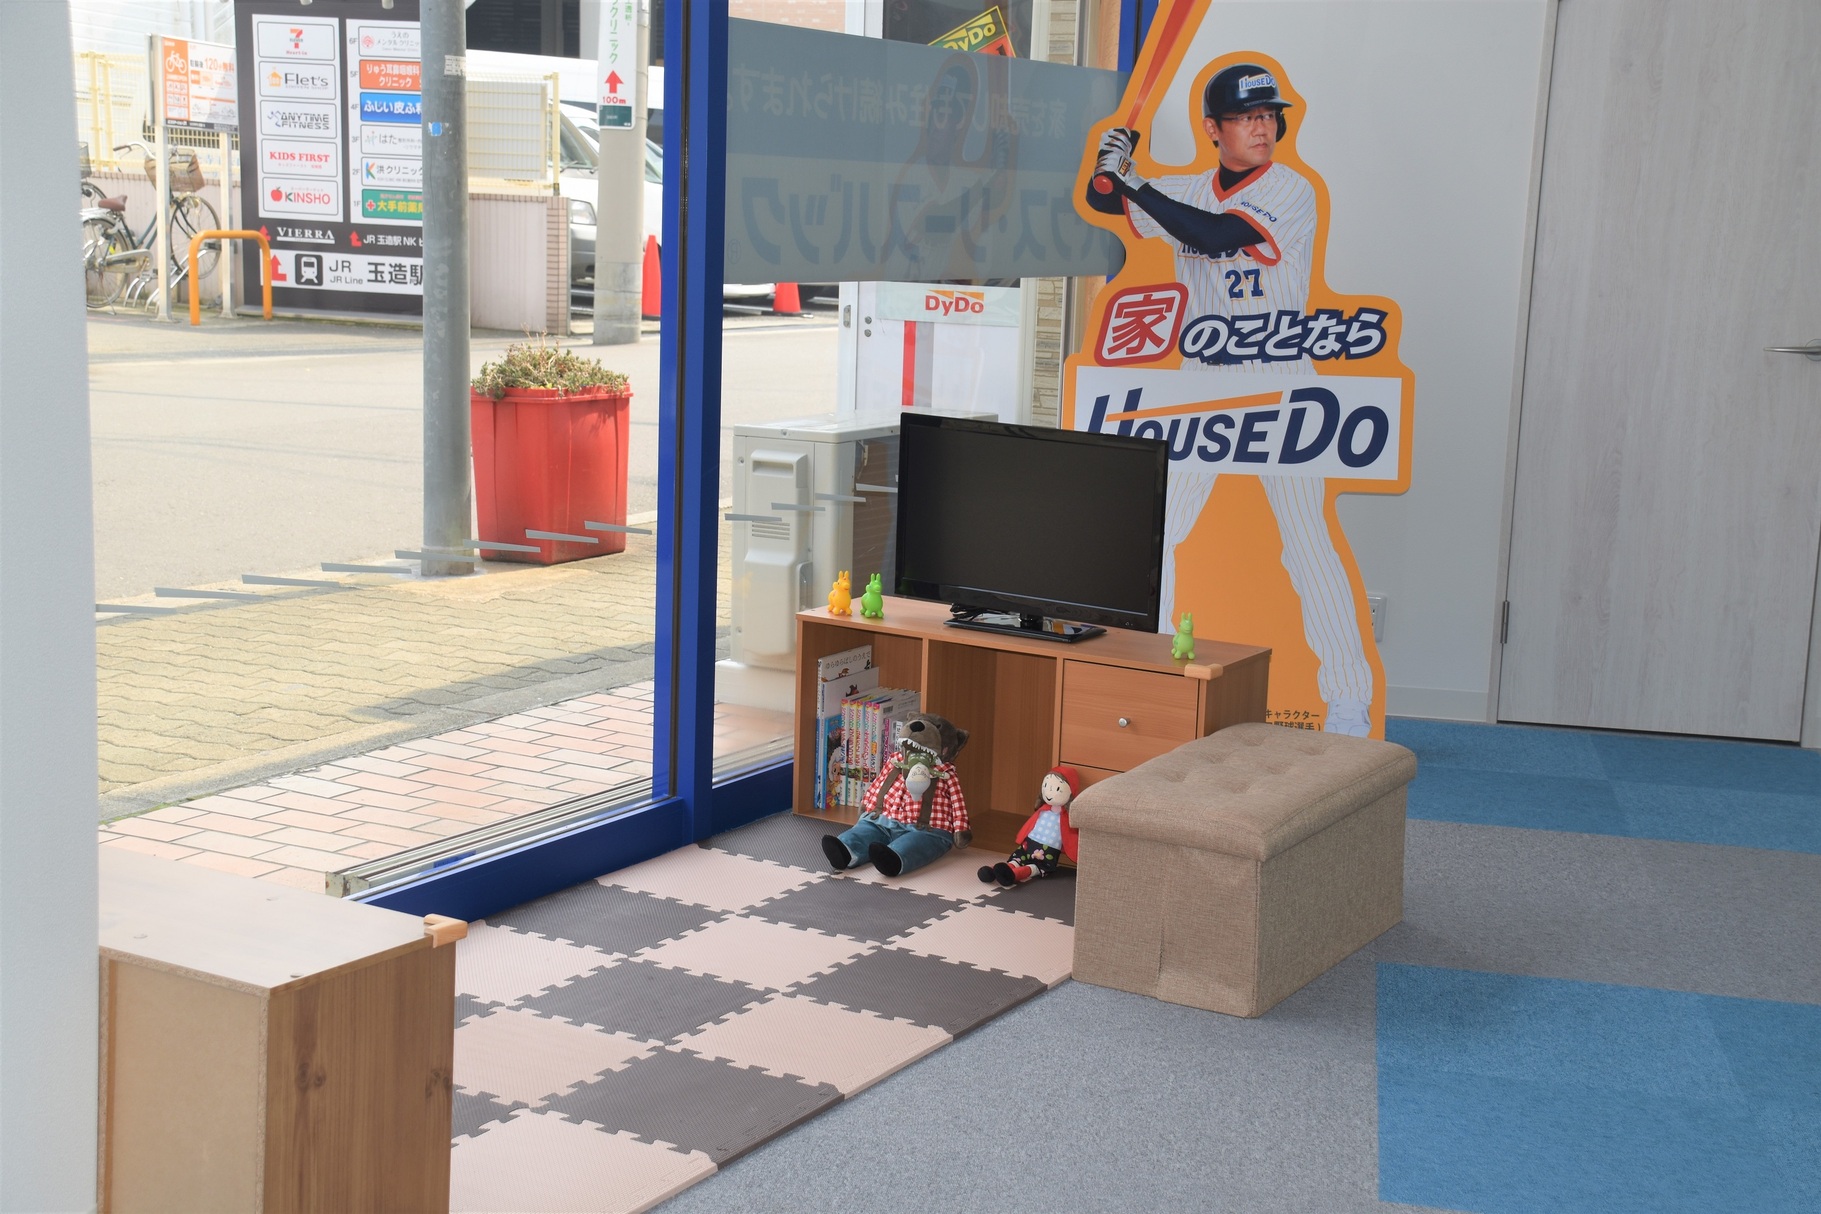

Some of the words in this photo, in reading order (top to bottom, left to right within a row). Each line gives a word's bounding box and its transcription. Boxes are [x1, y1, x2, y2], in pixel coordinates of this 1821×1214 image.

[284, 73, 329, 87] Flet's
[379, 76, 412, 88] クリニック
[602, 96, 626, 105] 100m
[280, 111, 330, 122] ANYTIME
[281, 121, 330, 130] FITNESS
[269, 151, 296, 161] KIDS
[299, 153, 330, 163] FIRST
[284, 191, 331, 205] KINSHO
[277, 227, 335, 240] VIERRA
[363, 235, 376, 245] JR
[403, 236, 417, 246] NK
[329, 259, 352, 273] JR
[367, 261, 423, 286] 玉造駅
[330, 275, 344, 283] JR
[344, 276, 363, 285] Line
[1225, 268, 1264, 299] 27
[925, 291, 984, 316] DyDo
